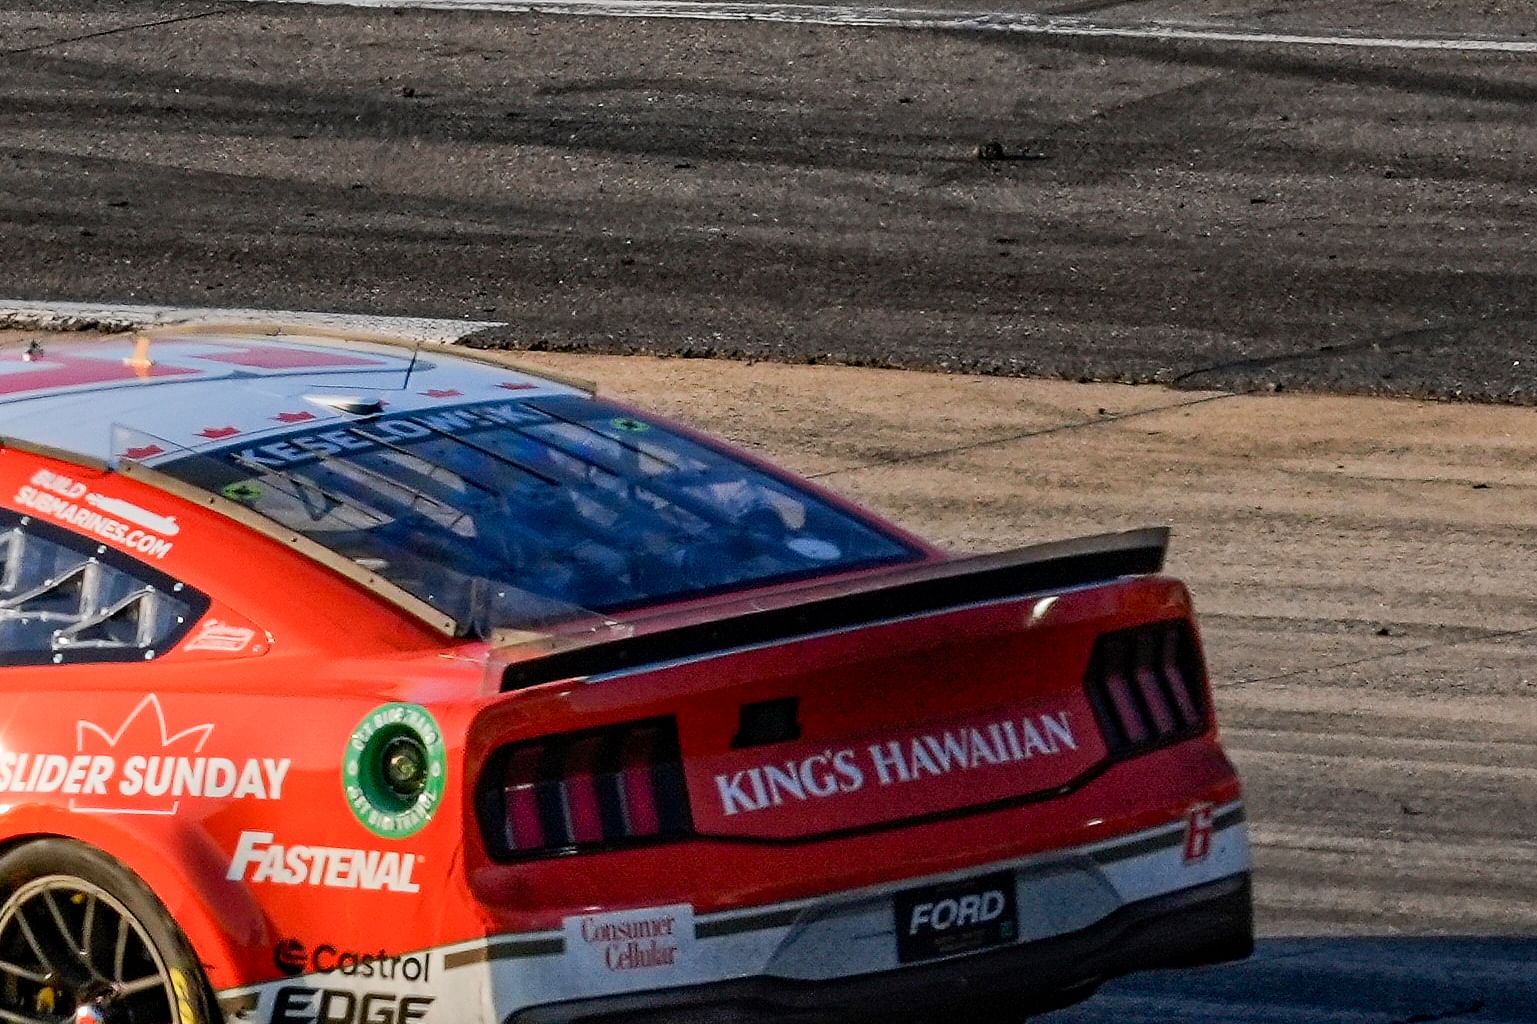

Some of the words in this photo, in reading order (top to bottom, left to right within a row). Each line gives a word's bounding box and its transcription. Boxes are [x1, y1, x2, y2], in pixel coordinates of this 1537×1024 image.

[30, 468, 88, 499] BUILD
[14, 485, 174, 559] SUBMARINES.COM
[122, 757, 292, 800] SUNDAY
[714, 748, 864, 816] KING'S
[867, 711, 1078, 785] HAWAIIAN
[1183, 804, 1213, 862] 6
[580, 915, 676, 943] Consumer
[909, 889, 1005, 936] FORD
[313, 942, 431, 982] Castrol
[604, 938, 677, 972] Cellular
